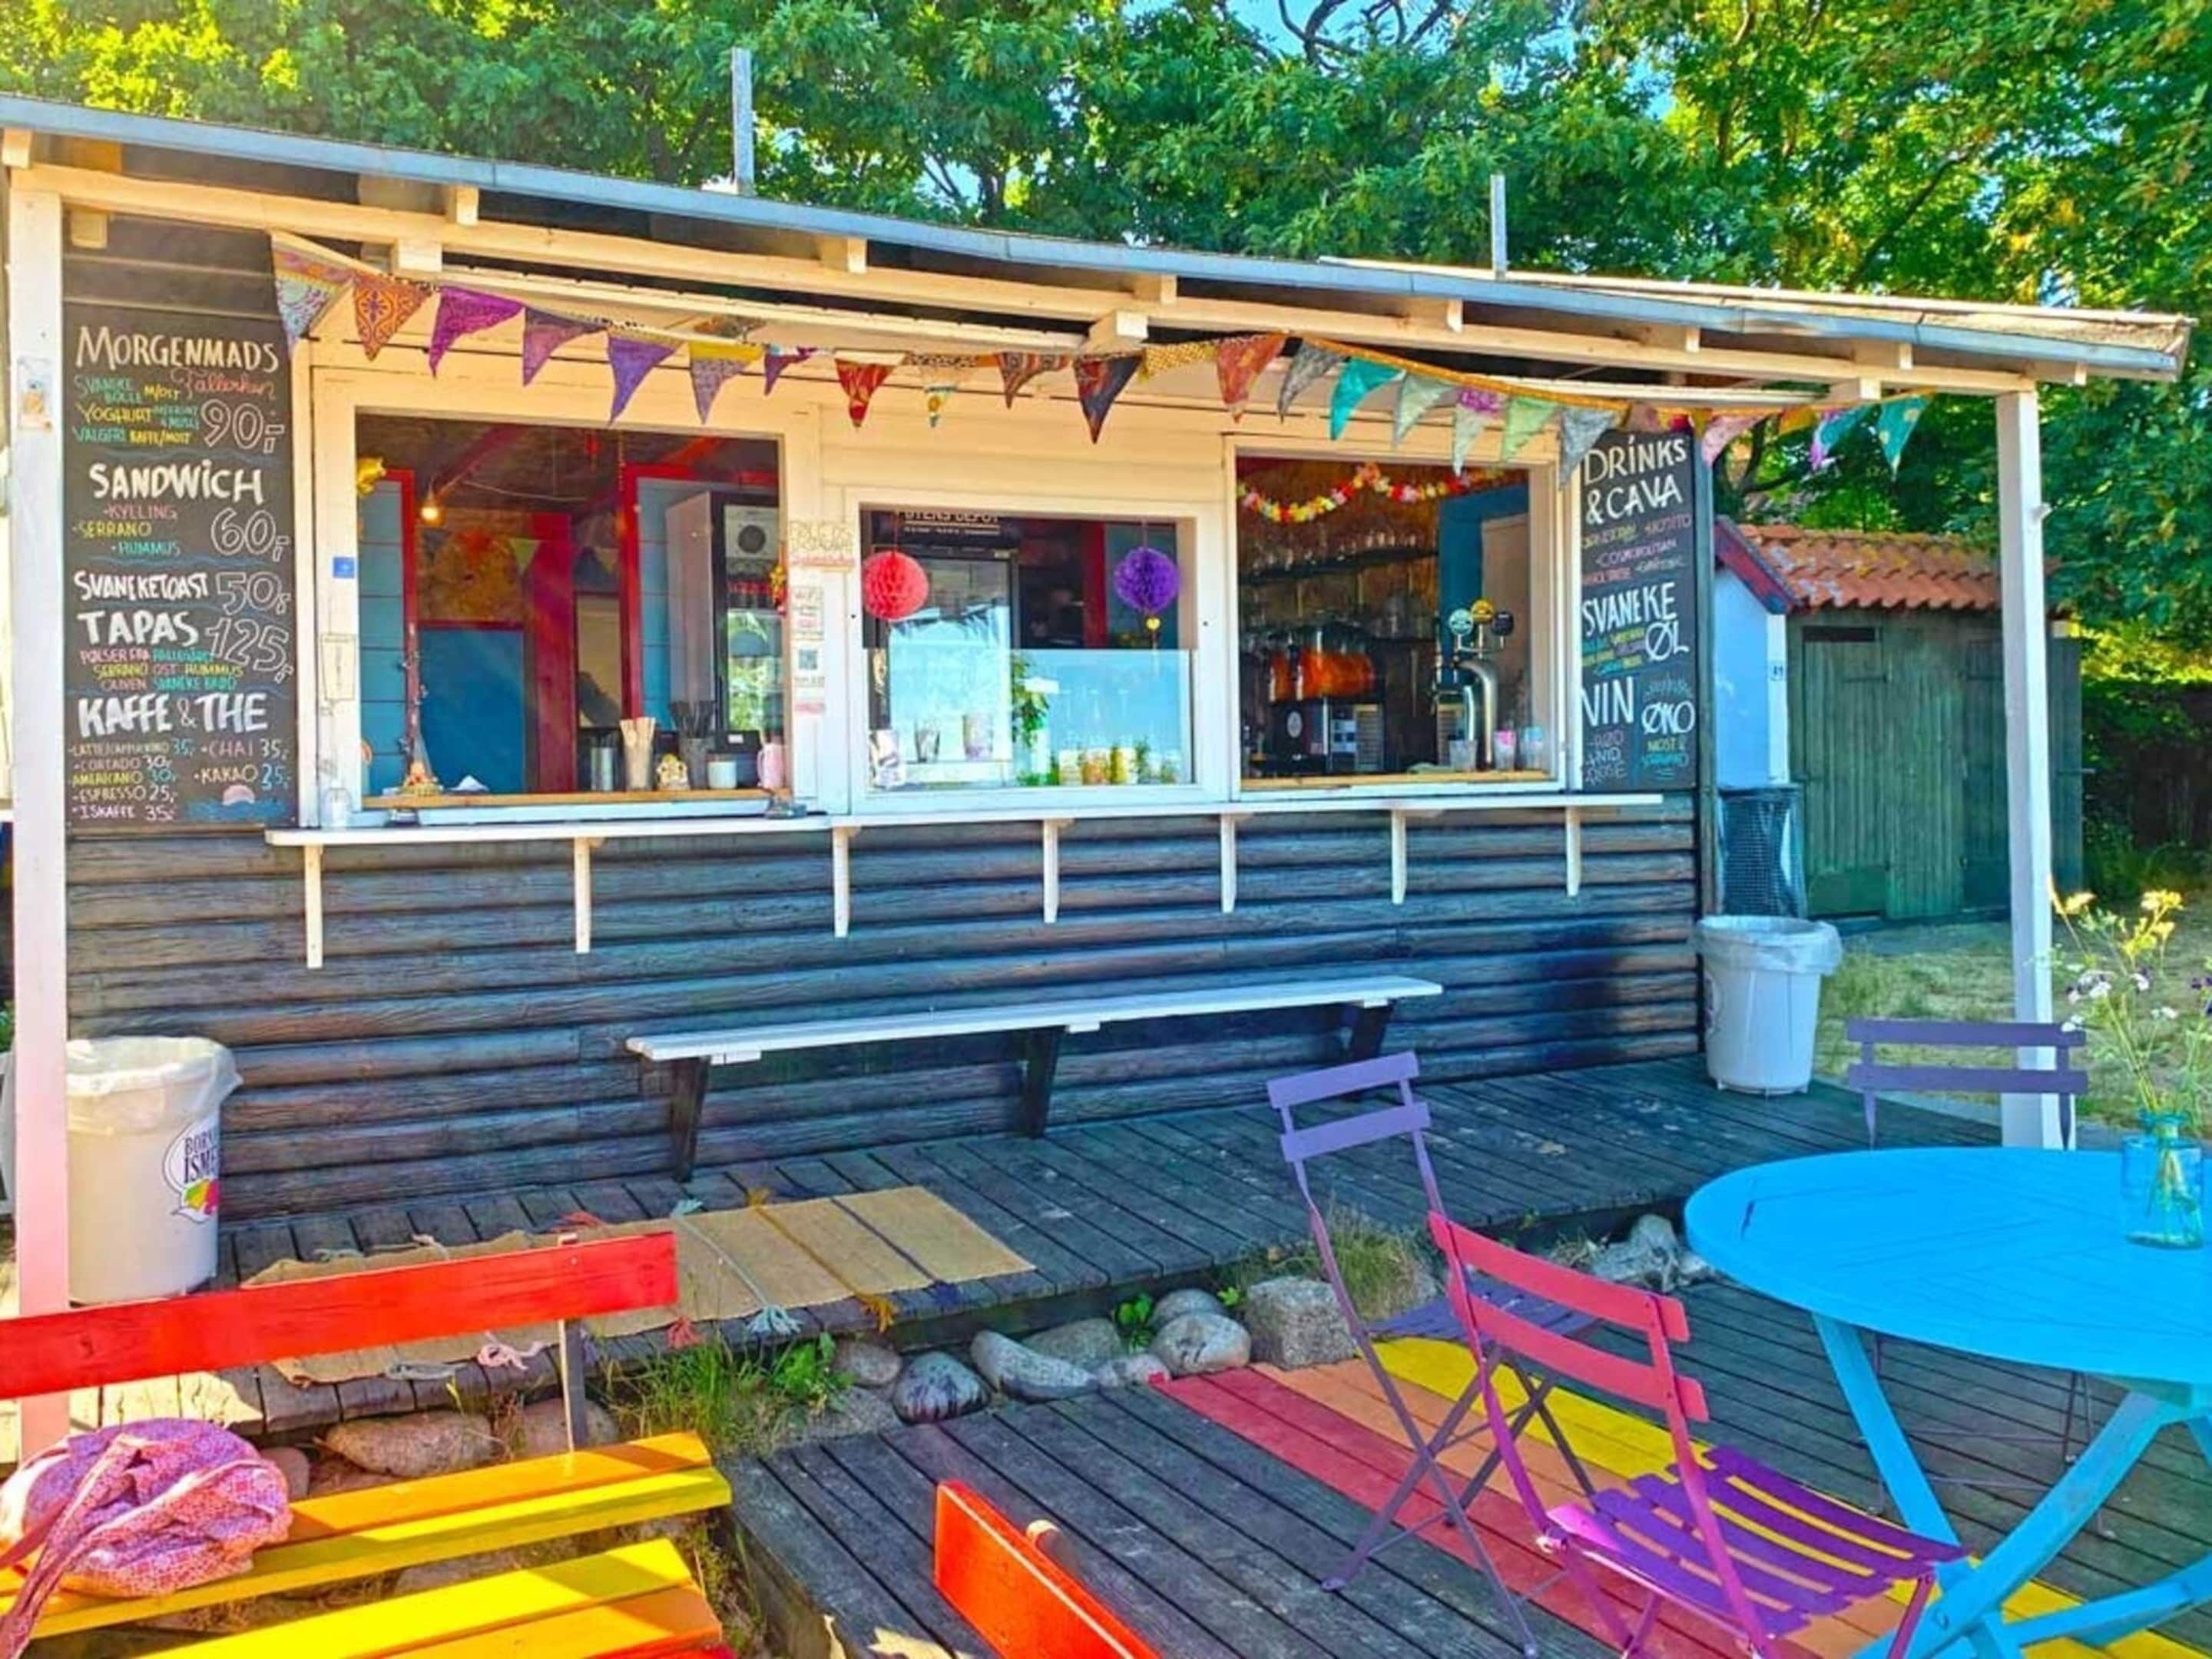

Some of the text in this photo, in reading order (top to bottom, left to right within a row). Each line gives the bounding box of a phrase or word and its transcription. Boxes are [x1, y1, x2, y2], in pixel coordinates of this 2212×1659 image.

[75, 326, 279, 373] MORGENMADS
[77, 402, 153, 424] YOGHURT
[89, 459, 264, 505] SANDWiCH
[77, 610, 200, 647] TAPAS
[1582, 582, 1677, 637] SVANEKE
[1645, 621, 1689, 661] ØL
[78, 692, 269, 738] KAFFE & THE
[1582, 676, 1634, 727] VIN
[1641, 700, 1695, 734] ØKO
